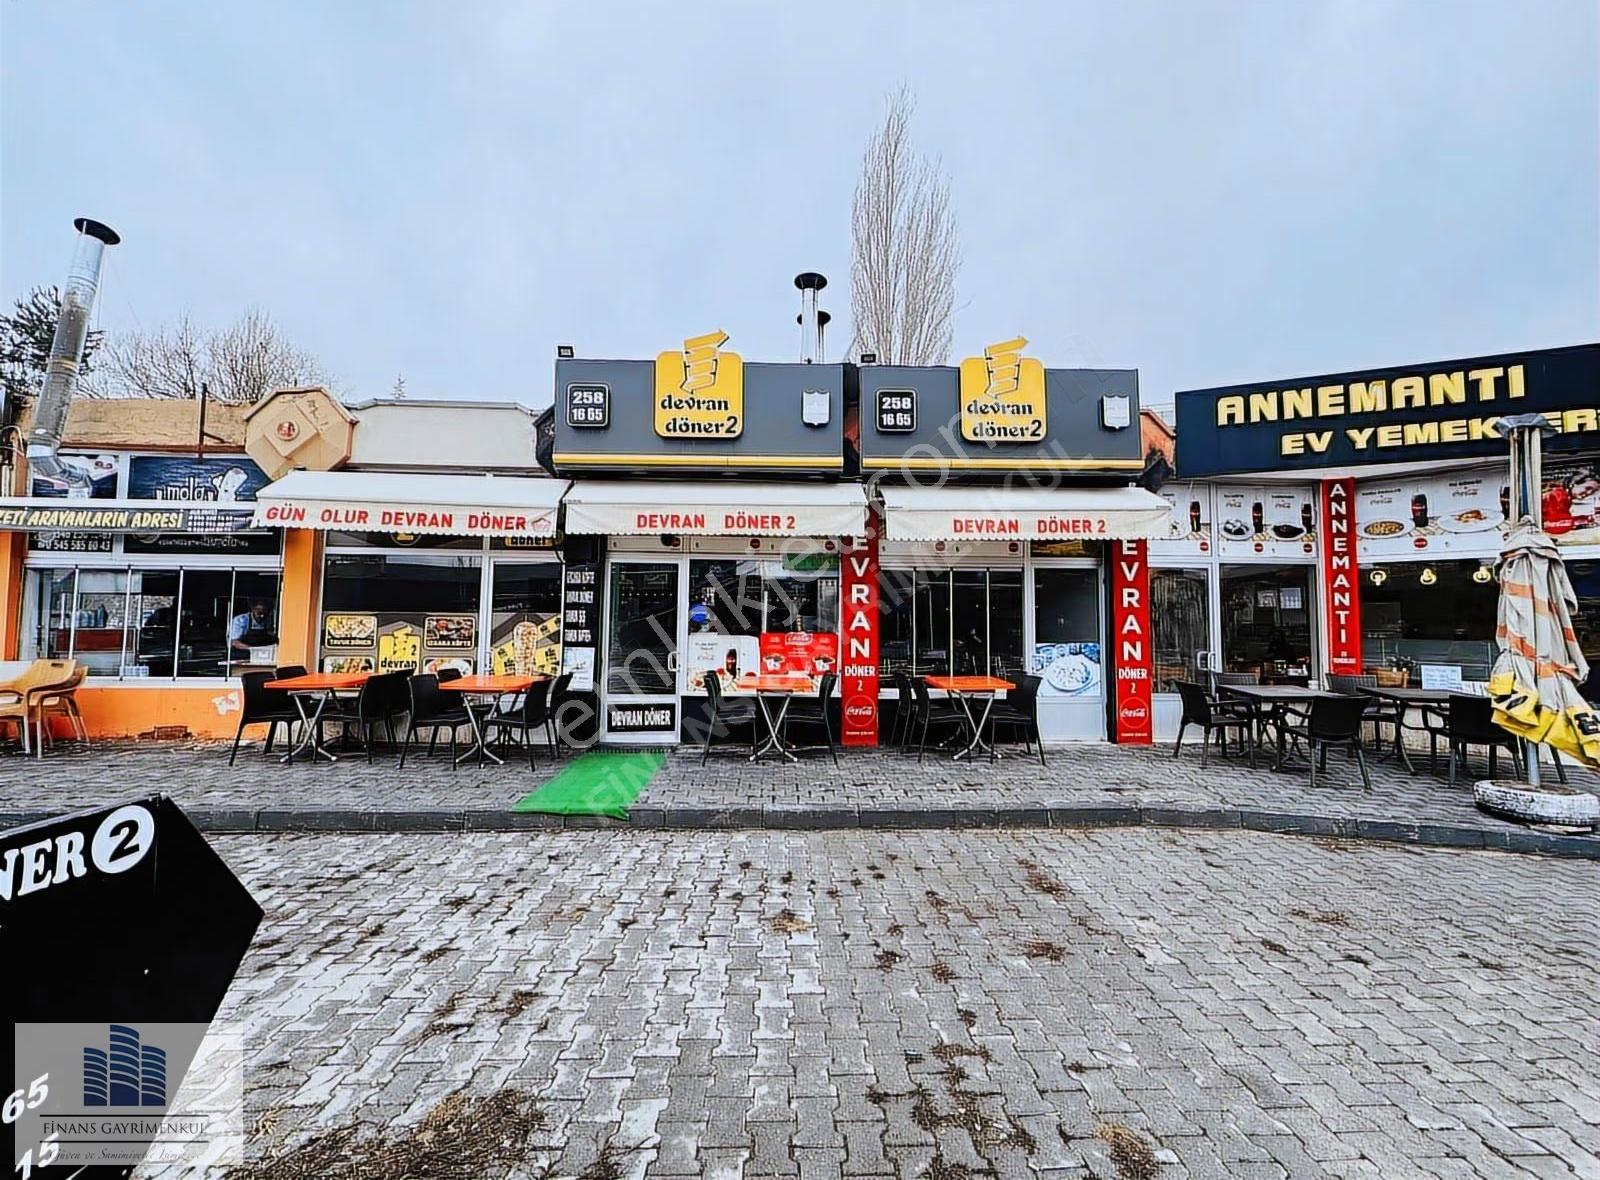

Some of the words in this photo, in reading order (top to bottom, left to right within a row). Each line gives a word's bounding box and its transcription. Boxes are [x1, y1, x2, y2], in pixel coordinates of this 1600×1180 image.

[572, 391, 604, 404] 258
[660, 394, 729, 410] devran
[881, 397, 912, 409] 258
[1217, 365, 1525, 426] ANNEMANTI
[967, 400, 1033, 415] devran
[1281, 431, 1333, 456] EV
[1345, 408, 1600, 450] YEMEKER
[27, 510, 129, 528] ARAYANLARIN
[131, 509, 184, 529] ADRESİ
[266, 503, 306, 522] GÜN
[320, 508, 369, 525] OLUR
[381, 511, 453, 528] DEVRAN
[468, 512, 527, 531] DÖNER
[637, 514, 705, 529] DEVRAN
[725, 512, 781, 529] DÖNER
[787, 515, 796, 529] 2
[953, 519, 1019, 534] DEVRAN
[1037, 516, 1093, 534] DÖNER
[1097, 520, 1106, 533] 2
[1329, 483, 1351, 644] ANNEMANTI
[381, 658, 417, 669] devran
[844, 665, 876, 677] DÖNER
[1118, 667, 1148, 680] DÖNER
[857, 680, 863, 692] 2
[1130, 682, 1137, 694] 2
[611, 710, 643, 726] DEVRAN
[644, 707, 671, 726] DÖNER
[108, 819, 140, 863] 2
[2, 1072, 49, 1124] 65
